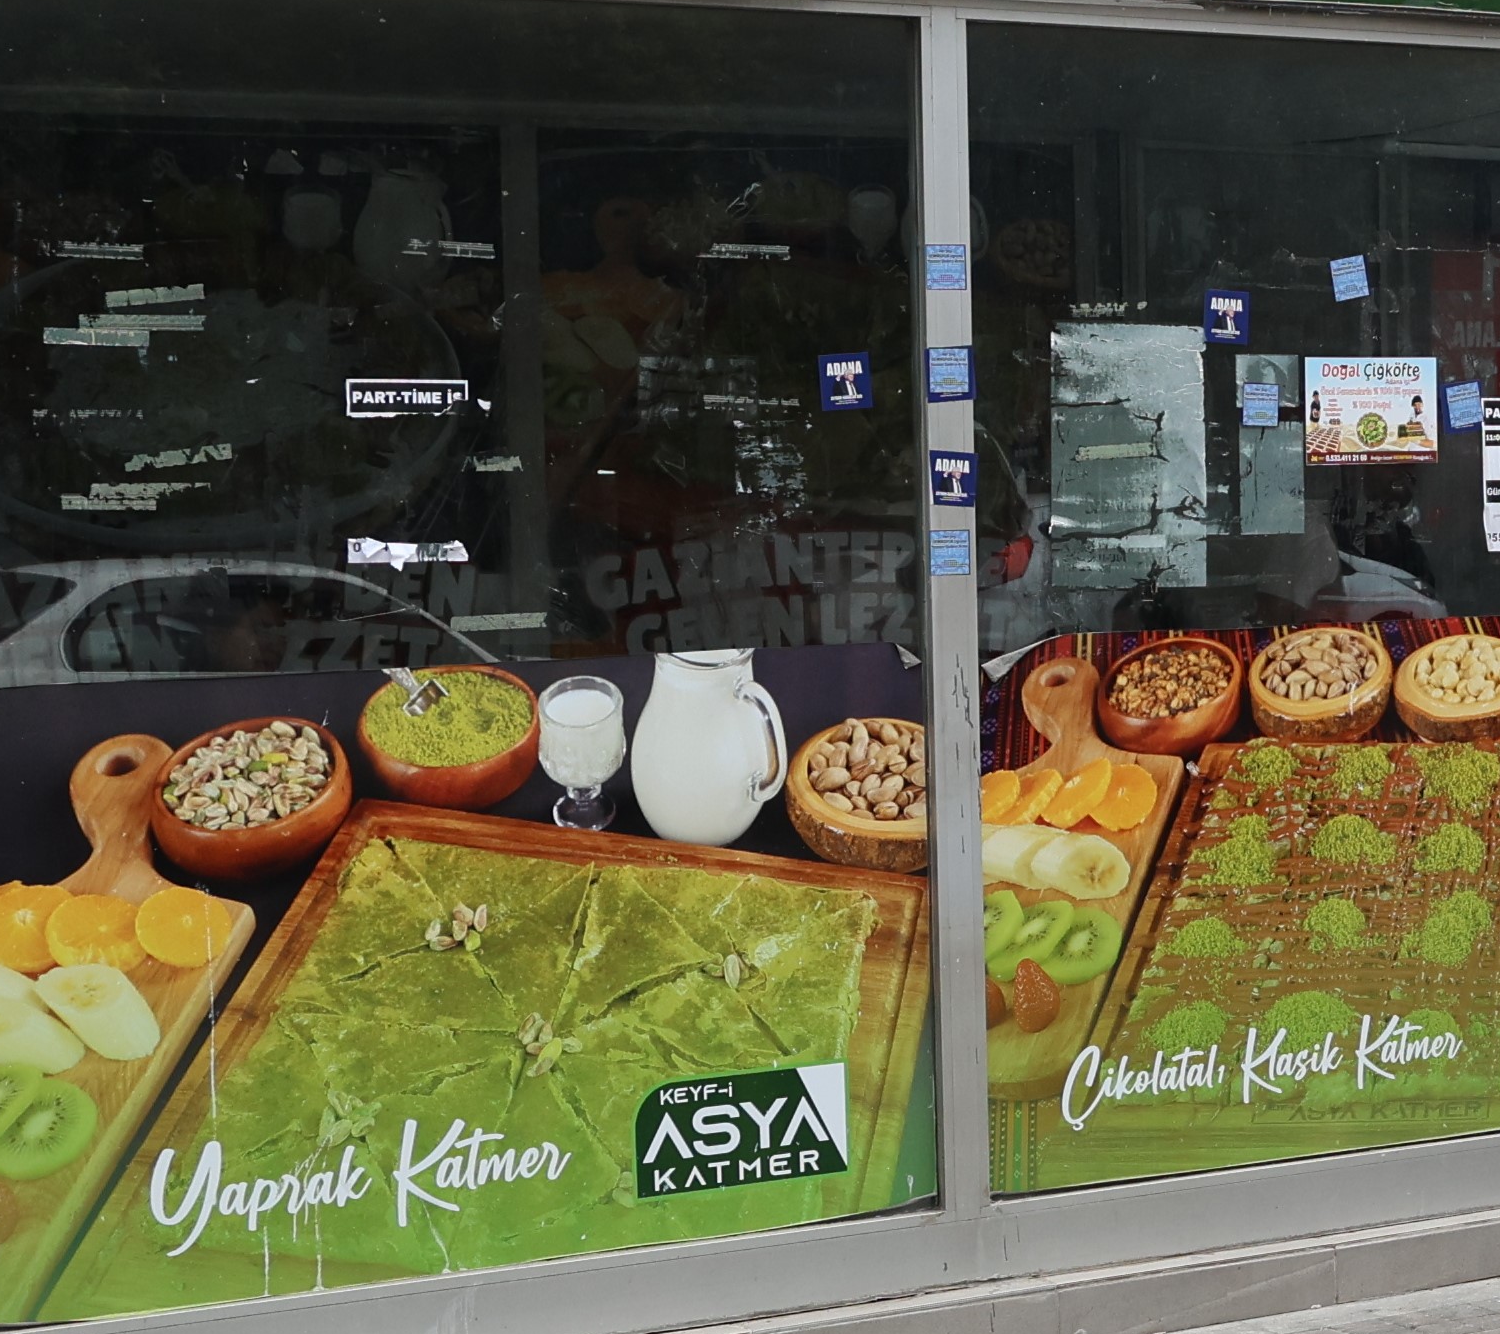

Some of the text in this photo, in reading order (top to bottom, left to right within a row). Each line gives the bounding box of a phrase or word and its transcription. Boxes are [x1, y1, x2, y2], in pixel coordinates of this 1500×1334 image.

[1211, 297, 1243, 312] ADANA
[827, 361, 863, 376] ADANA
[1322, 362, 1420, 381] Doğal Çiğköfte
[352, 388, 442, 404] PART-TİME
[935, 458, 970, 473] ADANA
[1241, 1027, 1343, 1104] Klasik
[1356, 1014, 1463, 1089] Katmer
[641, 1094, 830, 1167] ASYA
[653, 1148, 820, 1193] KATMER
[149, 1118, 572, 1259] Yaprak Katmer
